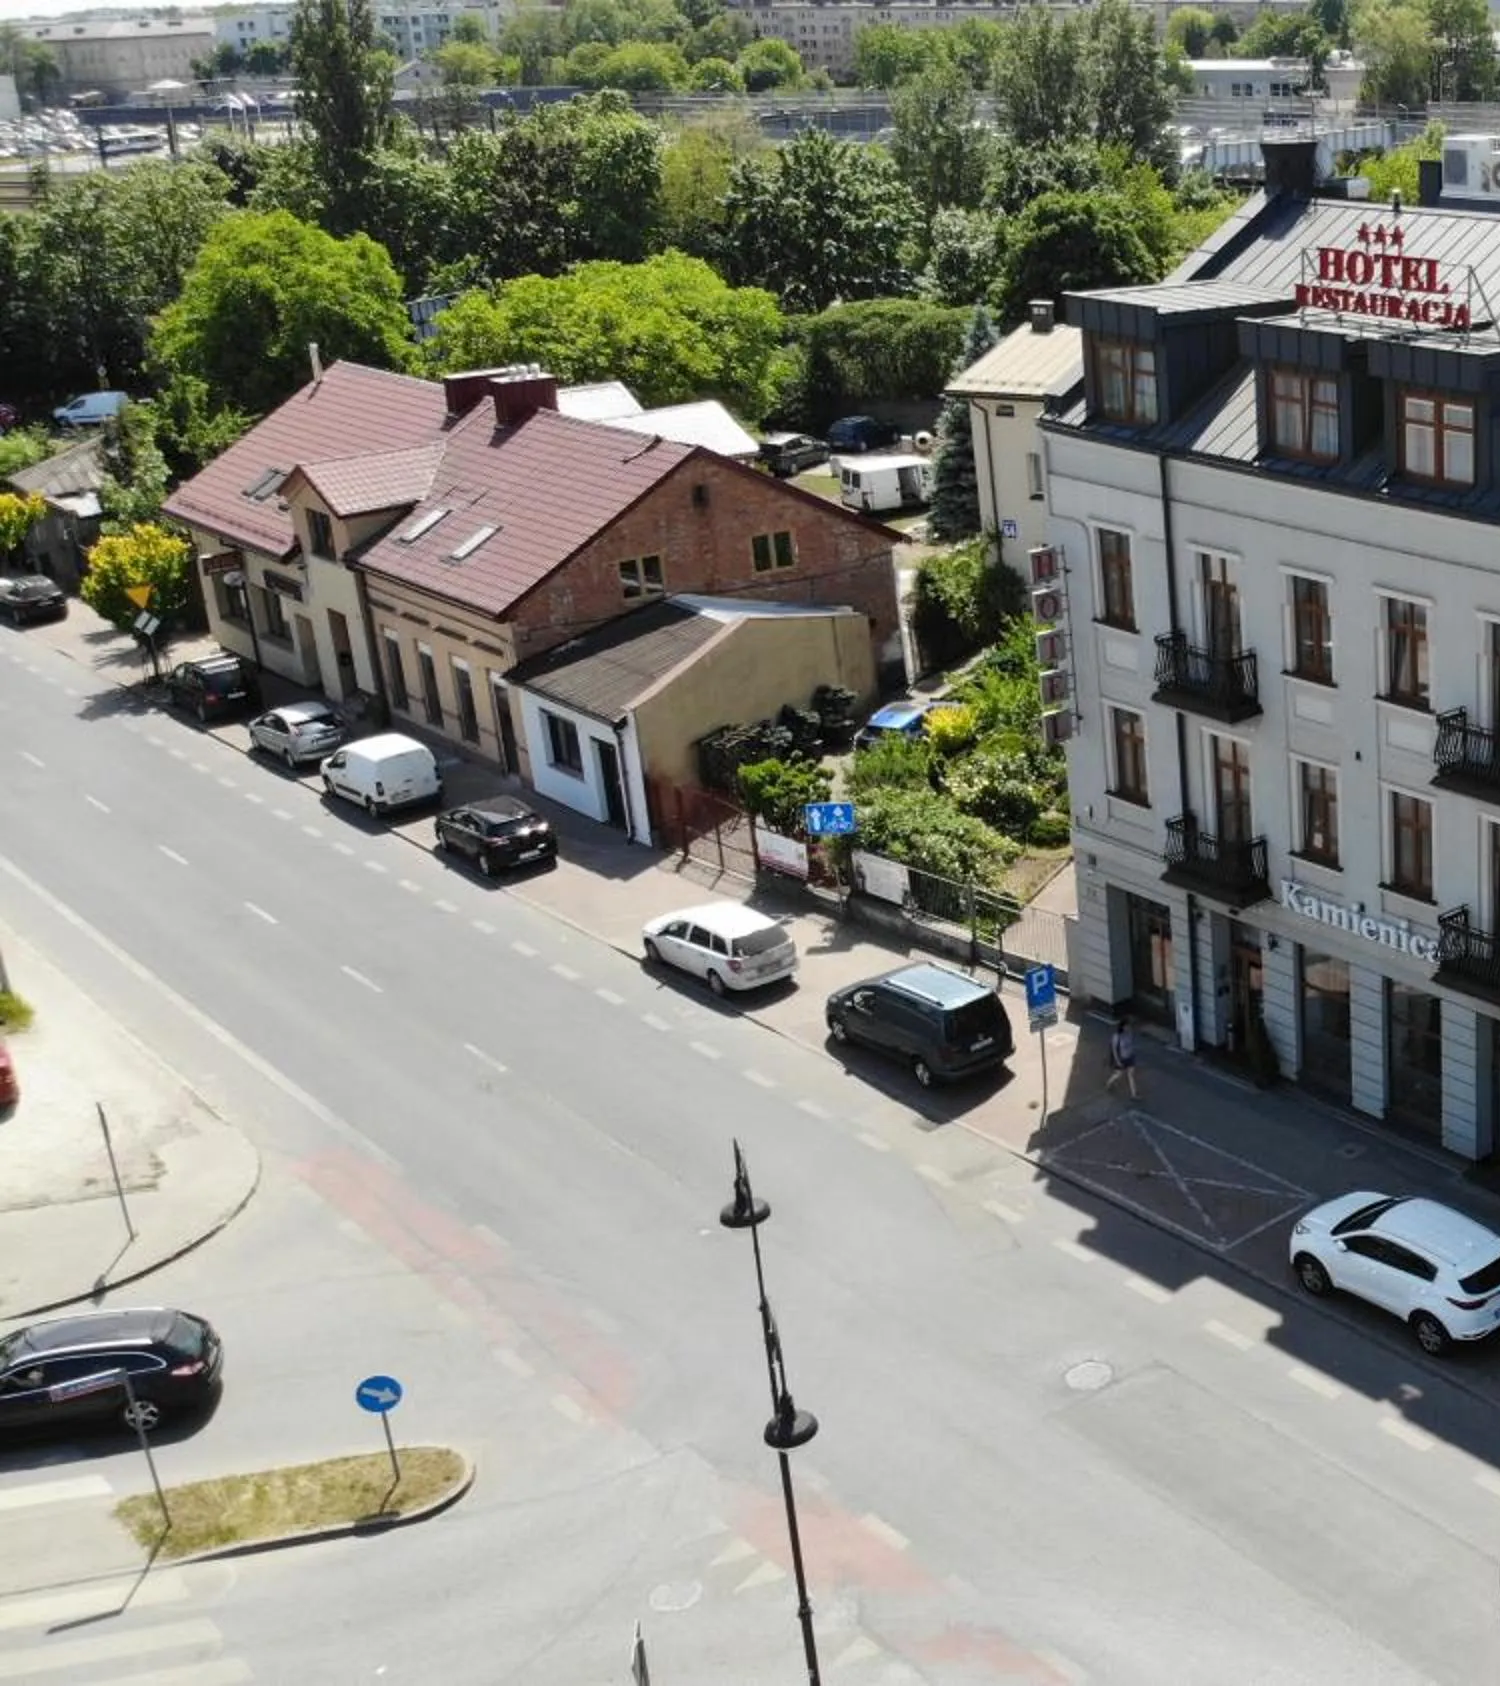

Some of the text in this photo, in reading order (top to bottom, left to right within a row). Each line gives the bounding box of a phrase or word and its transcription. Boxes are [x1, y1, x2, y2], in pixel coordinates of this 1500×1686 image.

[1317, 248, 1450, 294] HOTEL
[1295, 284, 1472, 328] RESTAURACJA
[1280, 879, 1441, 965] Kamienica
[1031, 970, 1050, 996] P
